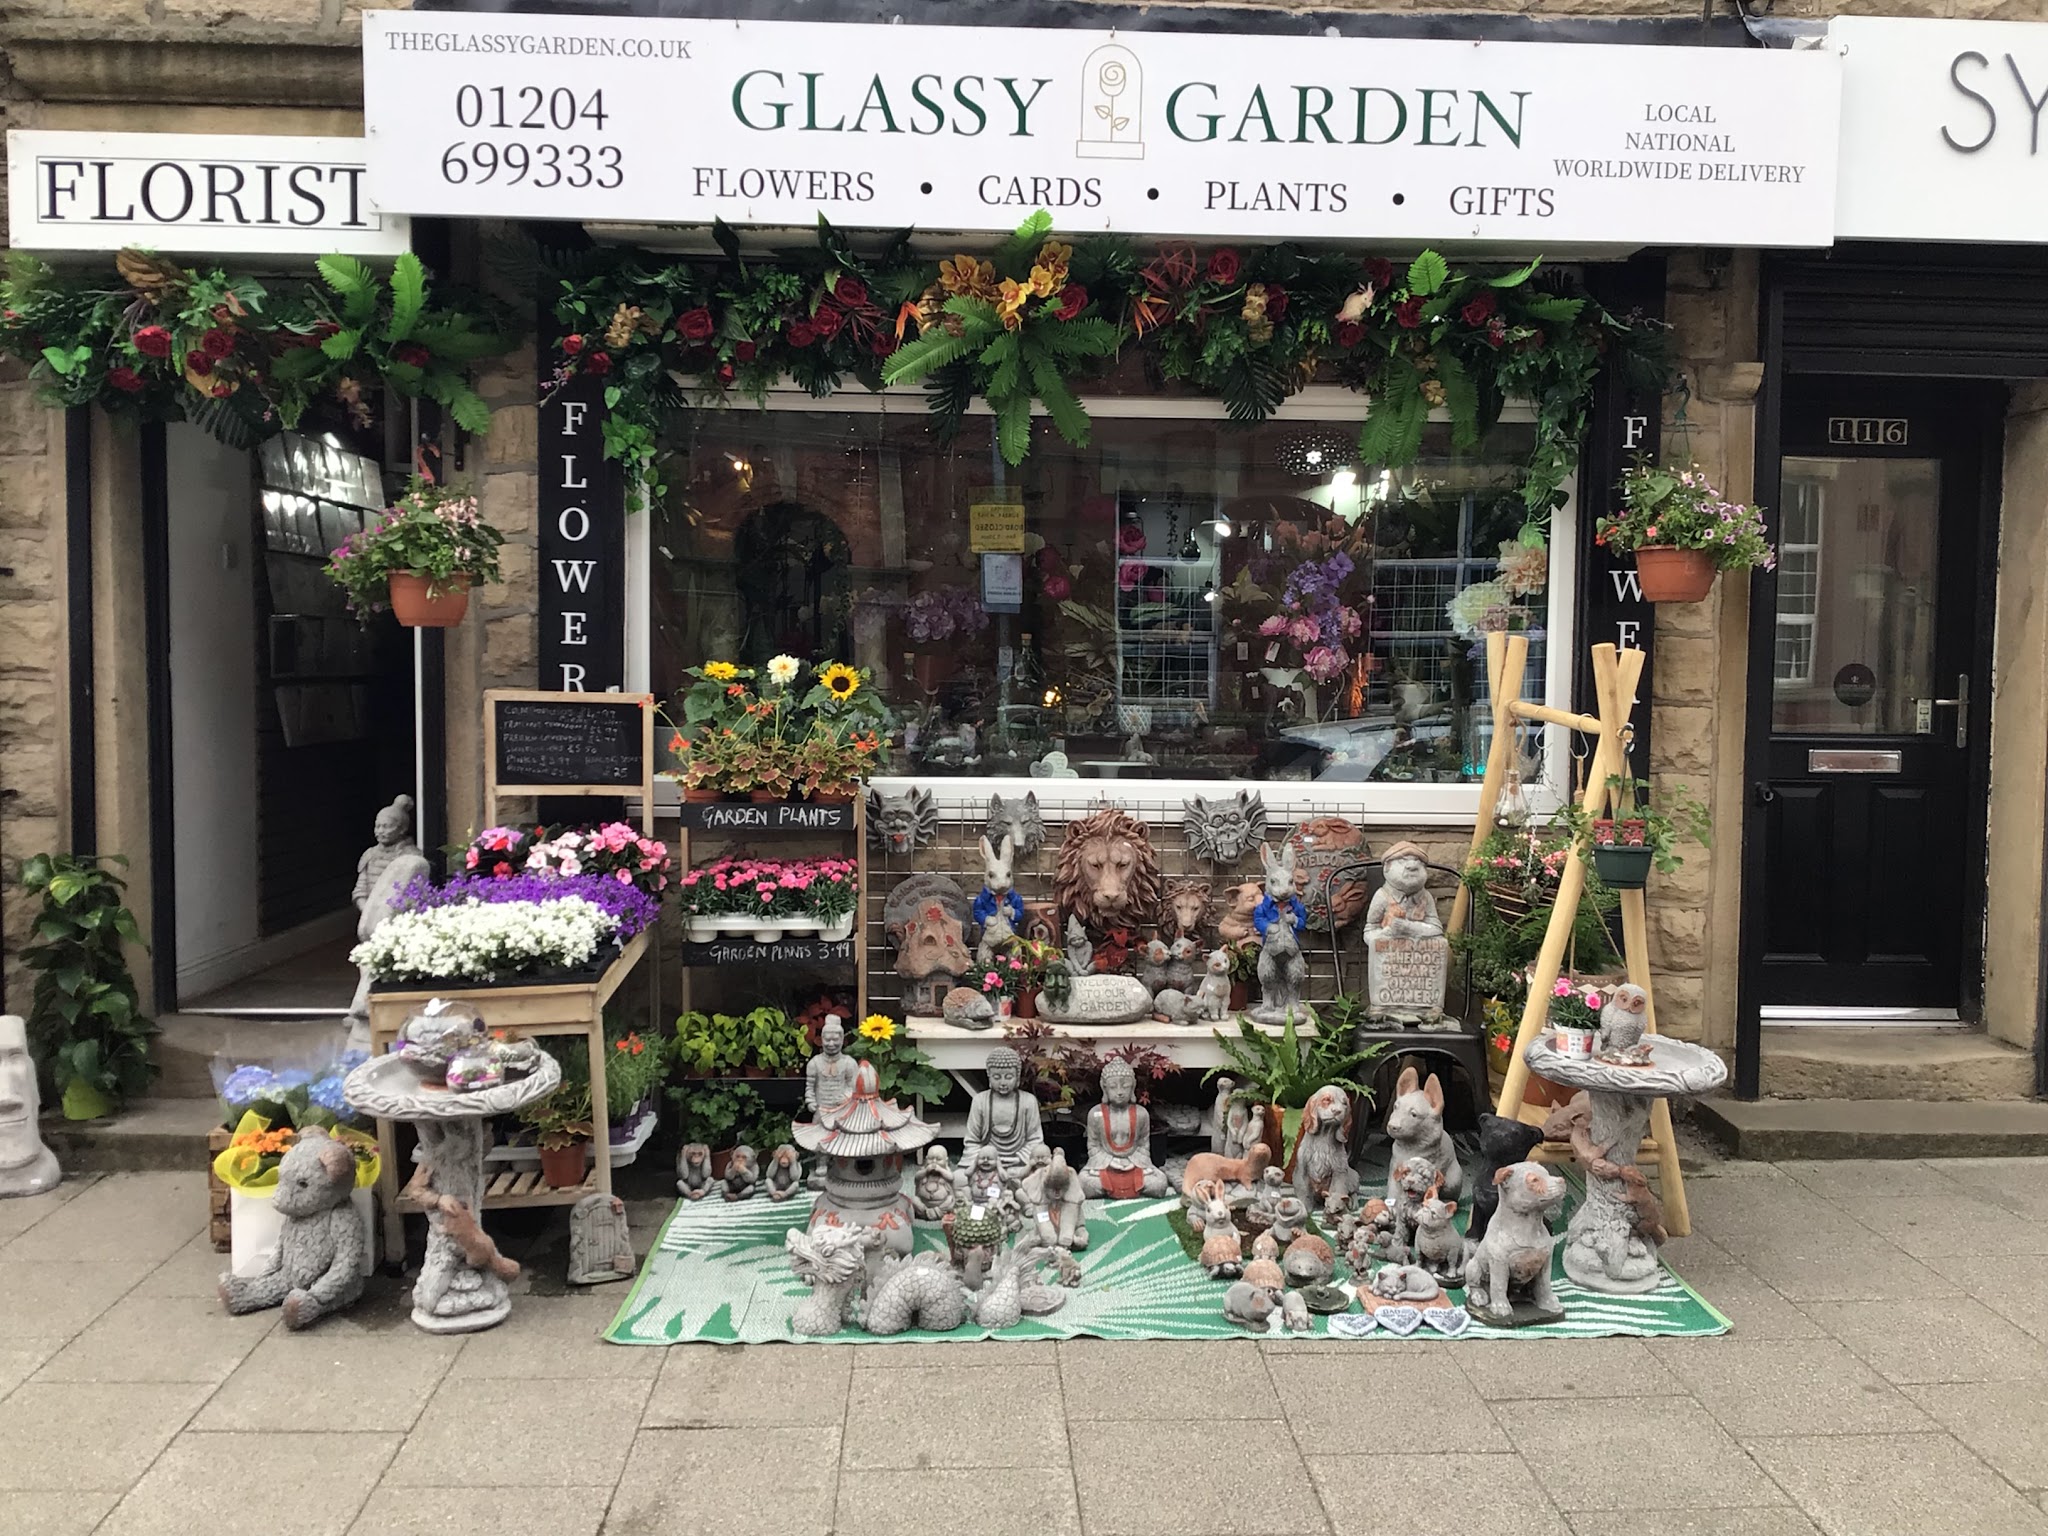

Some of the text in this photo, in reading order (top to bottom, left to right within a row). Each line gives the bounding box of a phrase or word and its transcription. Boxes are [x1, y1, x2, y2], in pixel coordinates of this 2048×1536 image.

[385, 31, 692, 59] THEGLASSYGARDEN.CO.UK
[456, 84, 609, 131] 01204
[732, 70, 1532, 149] GLASSY GARDEN
[1645, 104, 1716, 123] LOCAL
[1625, 132, 1735, 153] NATIONAL
[441, 141, 624, 189] 699333
[1553, 159, 1805, 183] WORLDWIDE DELIVERY
[40, 160, 367, 226] FLORIST
[692, 167, 875, 202] FLOWERS
[978, 175, 1102, 208] CARDS
[1204, 181, 1347, 213] PLANTS
[1449, 186, 1555, 218] GIFTS
[1837, 421, 1902, 443] 116
[702, 805, 841, 829] GARDEN PLANTS
[709, 944, 766, 964] GARDEN
[771, 945, 812, 962] PLANTS
[1386, 951, 1441, 966] THE DOG
[1381, 963, 1438, 978] BEWARE
[1077, 978, 1135, 988] WELCOME
[1084, 987, 1127, 999] TO OUR
[1079, 1000, 1133, 1013] GARDEN
